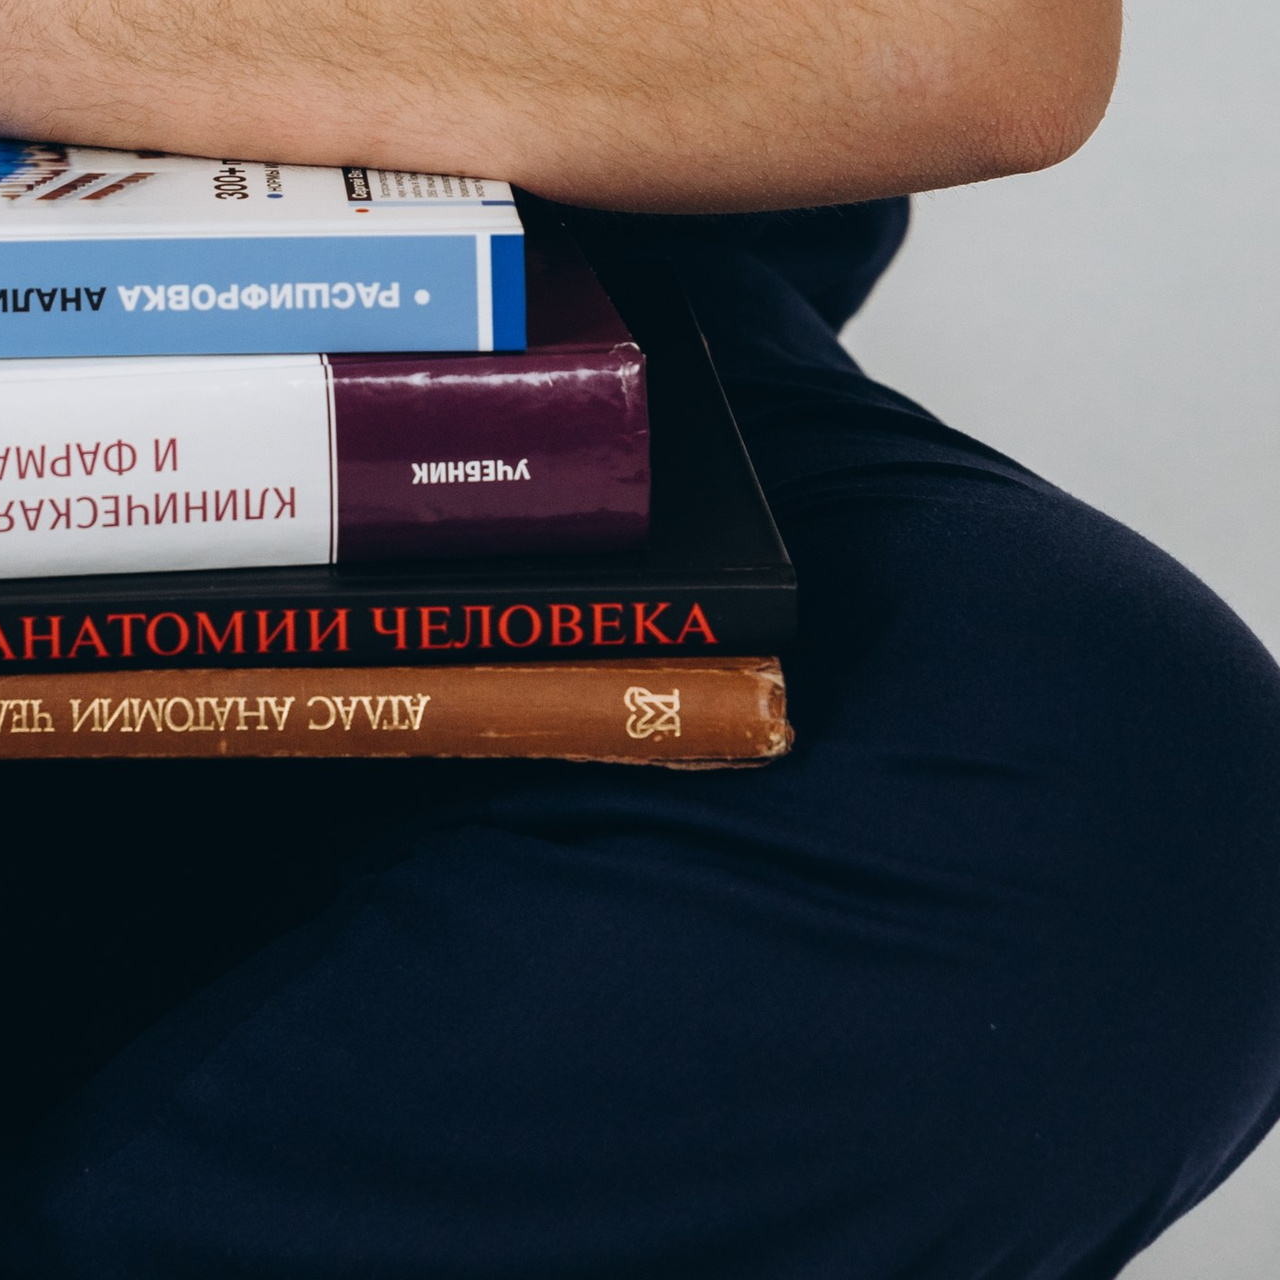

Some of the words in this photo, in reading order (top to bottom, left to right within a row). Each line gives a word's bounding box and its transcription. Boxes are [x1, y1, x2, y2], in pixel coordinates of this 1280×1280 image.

[212, 167, 250, 200] 300+
[264, 169, 282, 192] НОРМЫ
[348, 178, 370, 199] Сергей
[117, 282, 401, 312] РАСШИФРОВКА
[153, 437, 178, 473] И
[411, 458, 532, 485] УЧЕБНИК
[372, 601, 720, 651] ЧЕЛОВЕКА
[68, 695, 296, 732] АНАТОМИИ
[306, 692, 432, 731] АТЛАС
